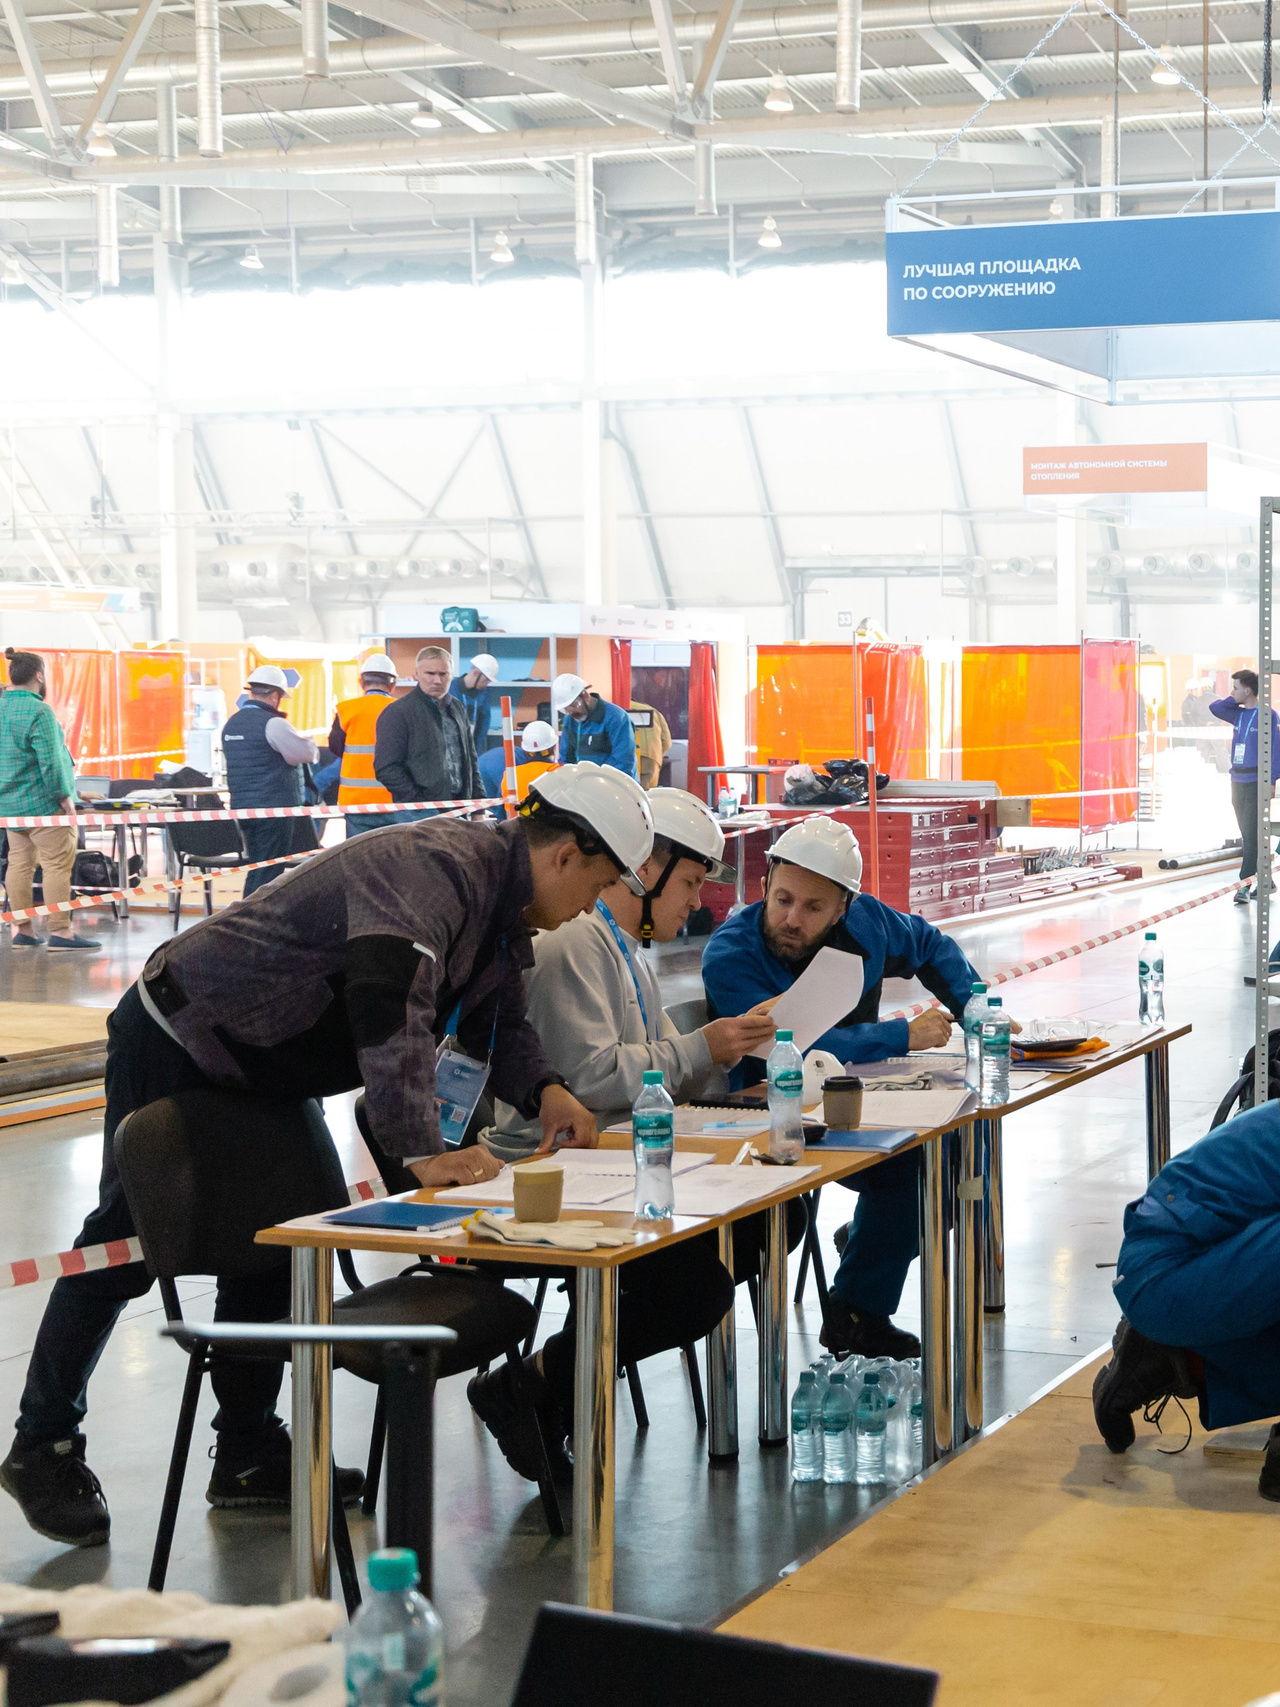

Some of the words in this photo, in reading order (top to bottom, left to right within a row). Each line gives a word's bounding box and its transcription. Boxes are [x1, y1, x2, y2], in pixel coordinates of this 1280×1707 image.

[903, 262, 975, 278] ЛУЧШАЯ
[980, 257, 1081, 274] ПЛОЩАДКА
[903, 287, 928, 300] ПО
[931, 281, 1056, 300] СООРУЖЕНИЮ
[1030, 462, 1067, 470] МОНТАЖ
[1068, 459, 1126, 469] АВТОНОМНОЙ
[1127, 459, 1168, 468] СИСТЕМЫ
[1030, 472, 1080, 481] ОТОПЛЕНИЯ
[839, 614, 851, 625] 33
